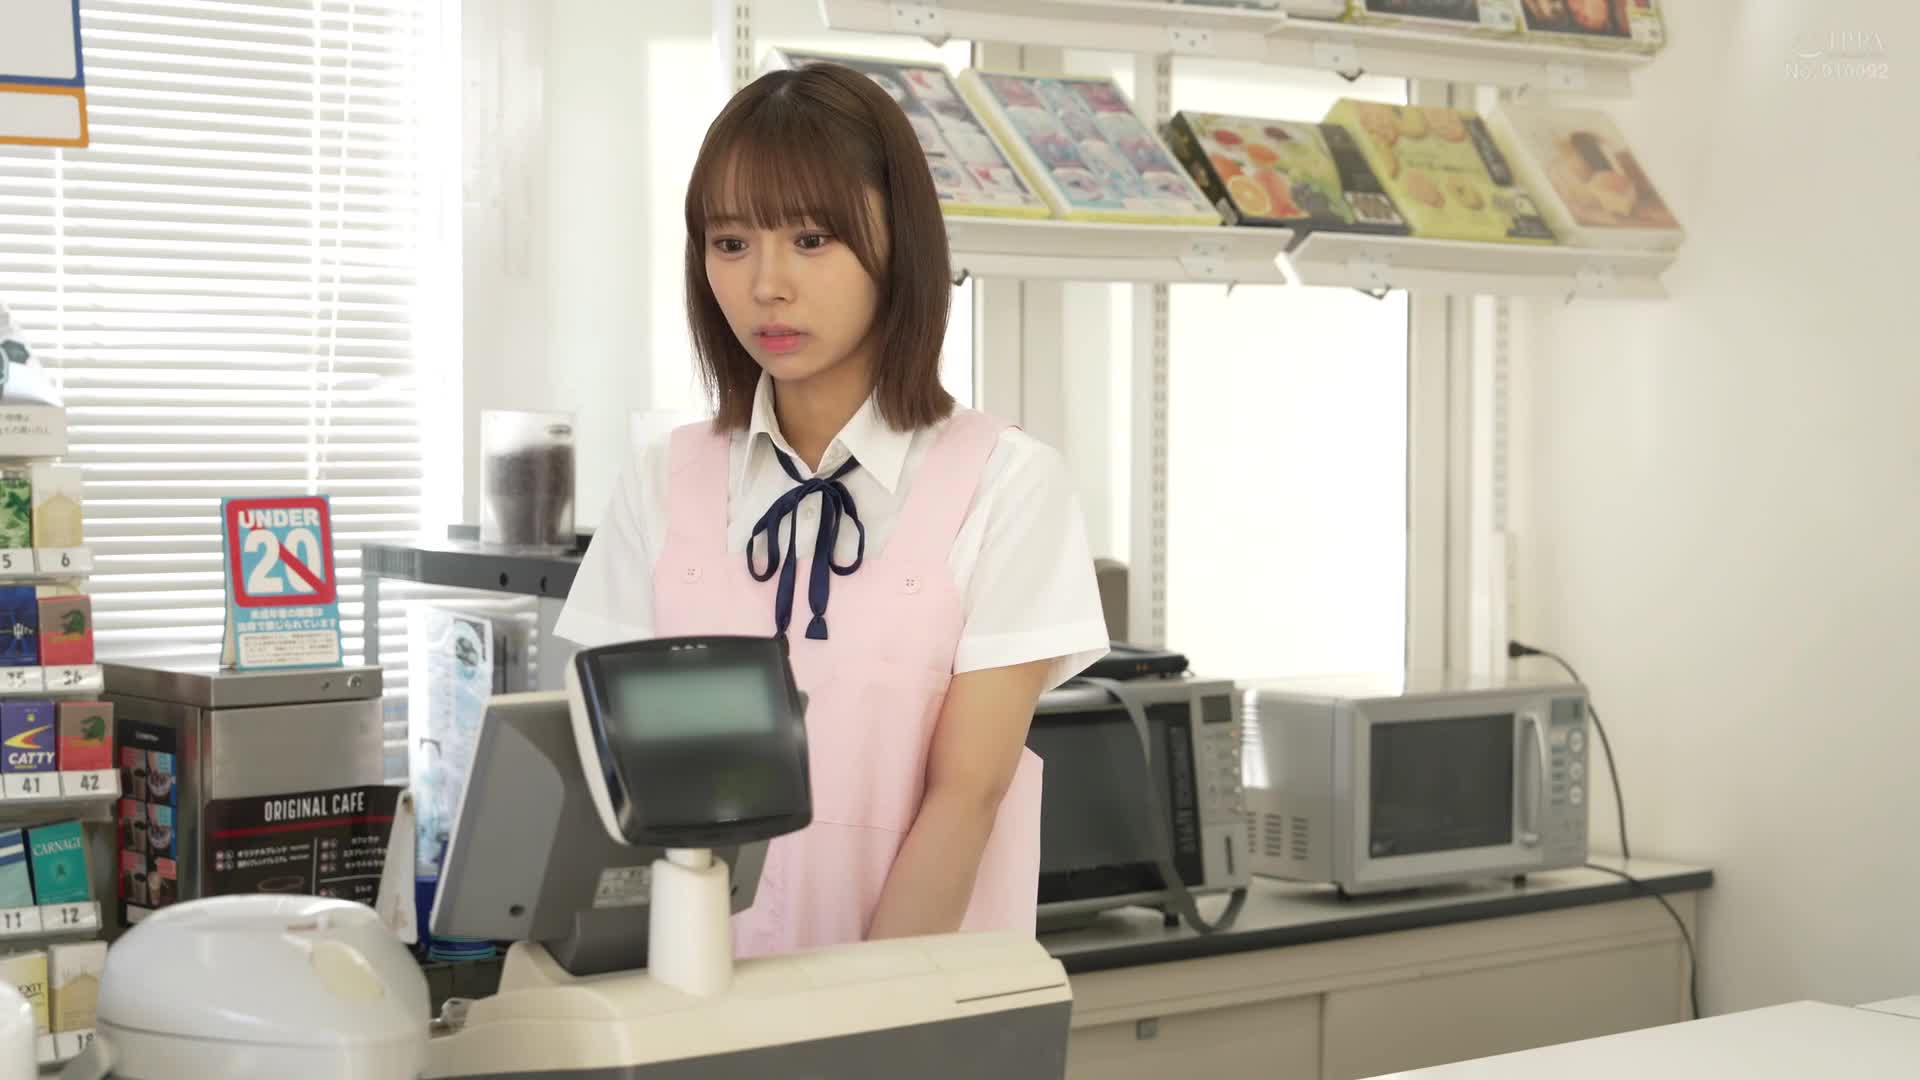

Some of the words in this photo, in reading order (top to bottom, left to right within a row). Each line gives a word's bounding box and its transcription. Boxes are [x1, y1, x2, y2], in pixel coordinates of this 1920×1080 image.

[238, 508, 319, 528] UNDER
[3, 553, 12, 568] 5
[61, 553, 70, 567] 6
[244, 527, 321, 593] 20
[8, 752, 55, 765] CATTY
[22, 777, 40, 793] 41
[80, 775, 99, 791] 42
[264, 796, 328, 822] ORIGINAL
[332, 791, 365, 814] CAFE
[33, 837, 81, 857] CARNAGE
[5, 913, 22, 929] 11
[61, 907, 79, 924] 12
[17, 983, 42, 993] EXIT
